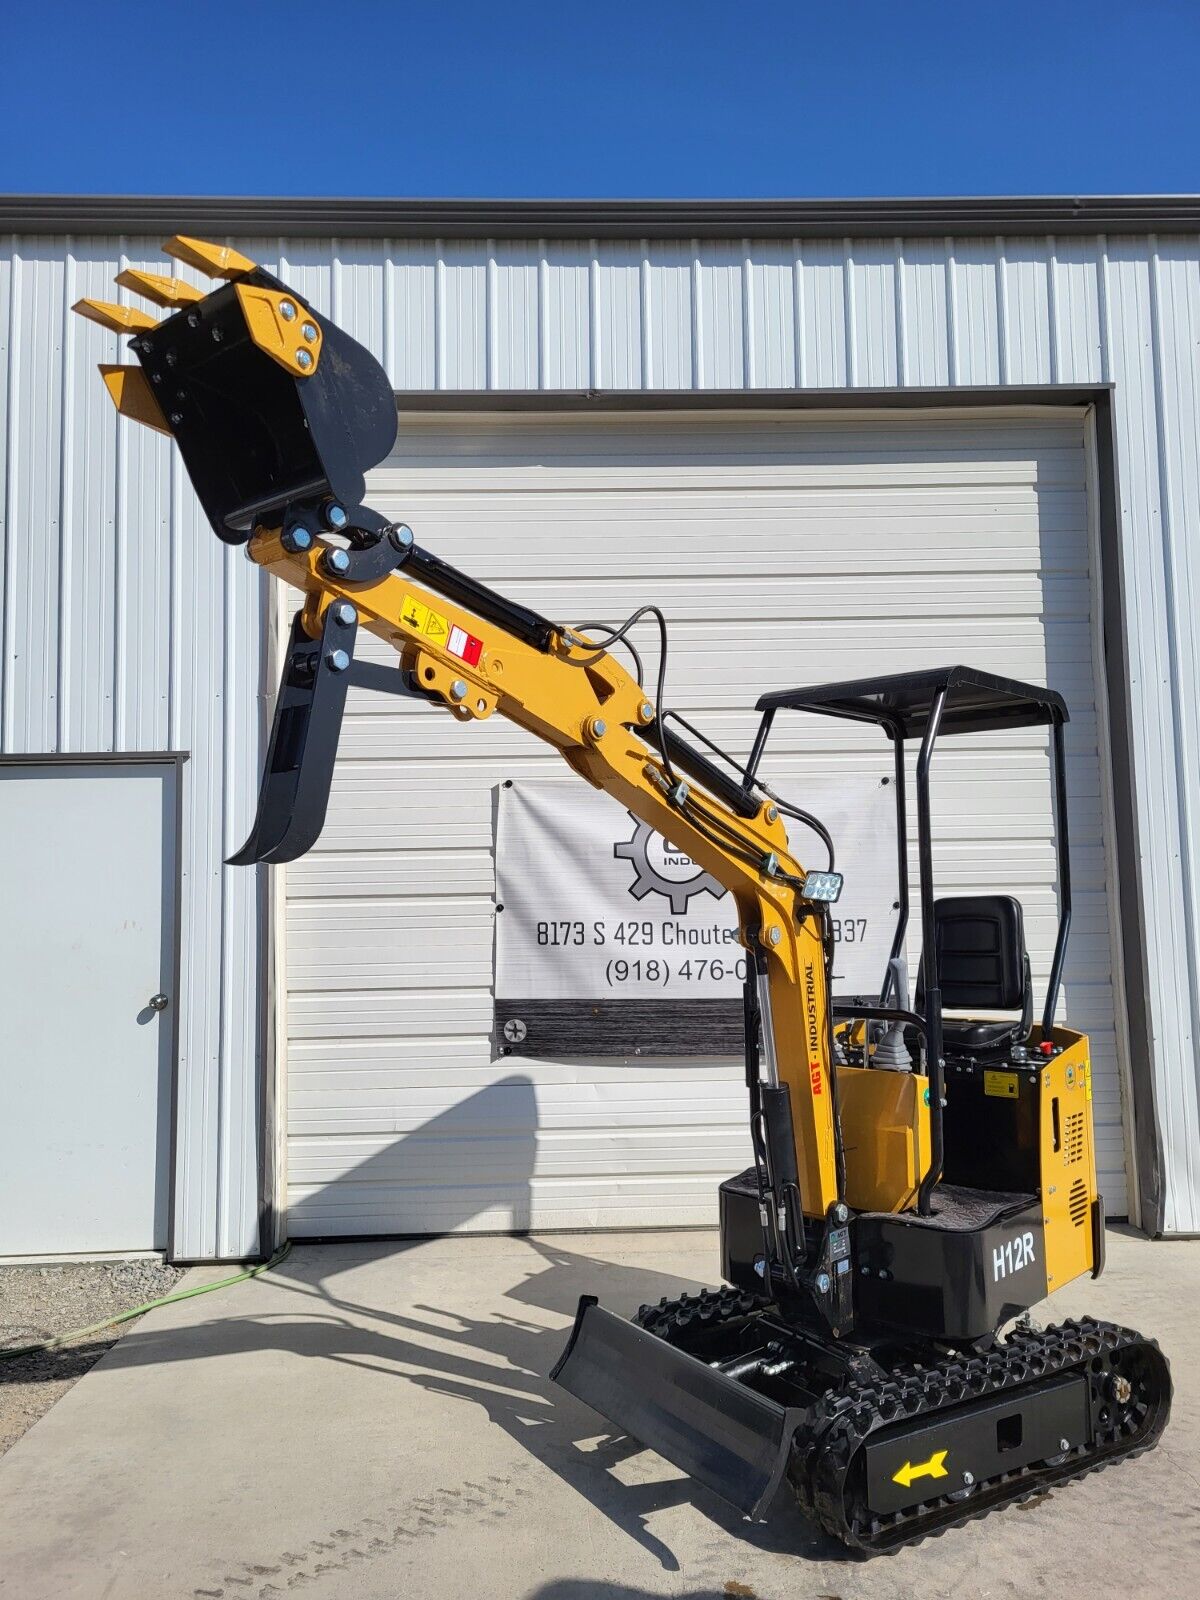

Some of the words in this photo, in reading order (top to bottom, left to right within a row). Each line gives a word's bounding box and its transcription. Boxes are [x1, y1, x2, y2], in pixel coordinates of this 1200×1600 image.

[537, 922, 585, 945] 8173
[593, 922, 605, 945] S
[614, 922, 653, 945] 429
[606, 960, 670, 987] (918)
[810, 1062, 822, 1095] AGT
[993, 1232, 1036, 1282] H12R
